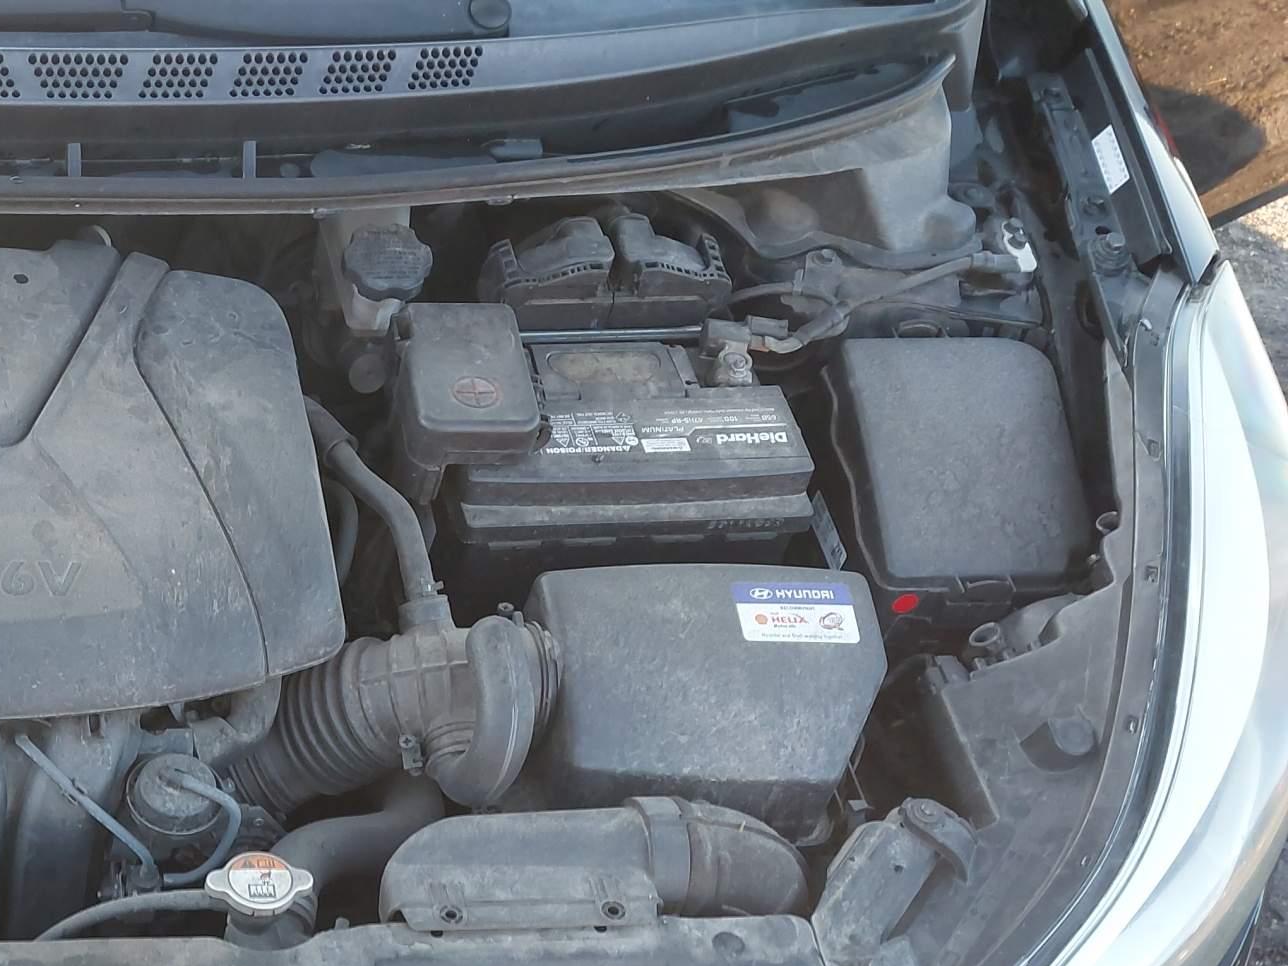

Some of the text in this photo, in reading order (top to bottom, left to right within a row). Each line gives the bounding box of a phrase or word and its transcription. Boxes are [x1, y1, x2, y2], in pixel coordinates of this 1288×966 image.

[716, 431, 789, 446] DieHard
[776, 589, 834, 600] HYUNDAI
[771, 615, 808, 624] HELIX
